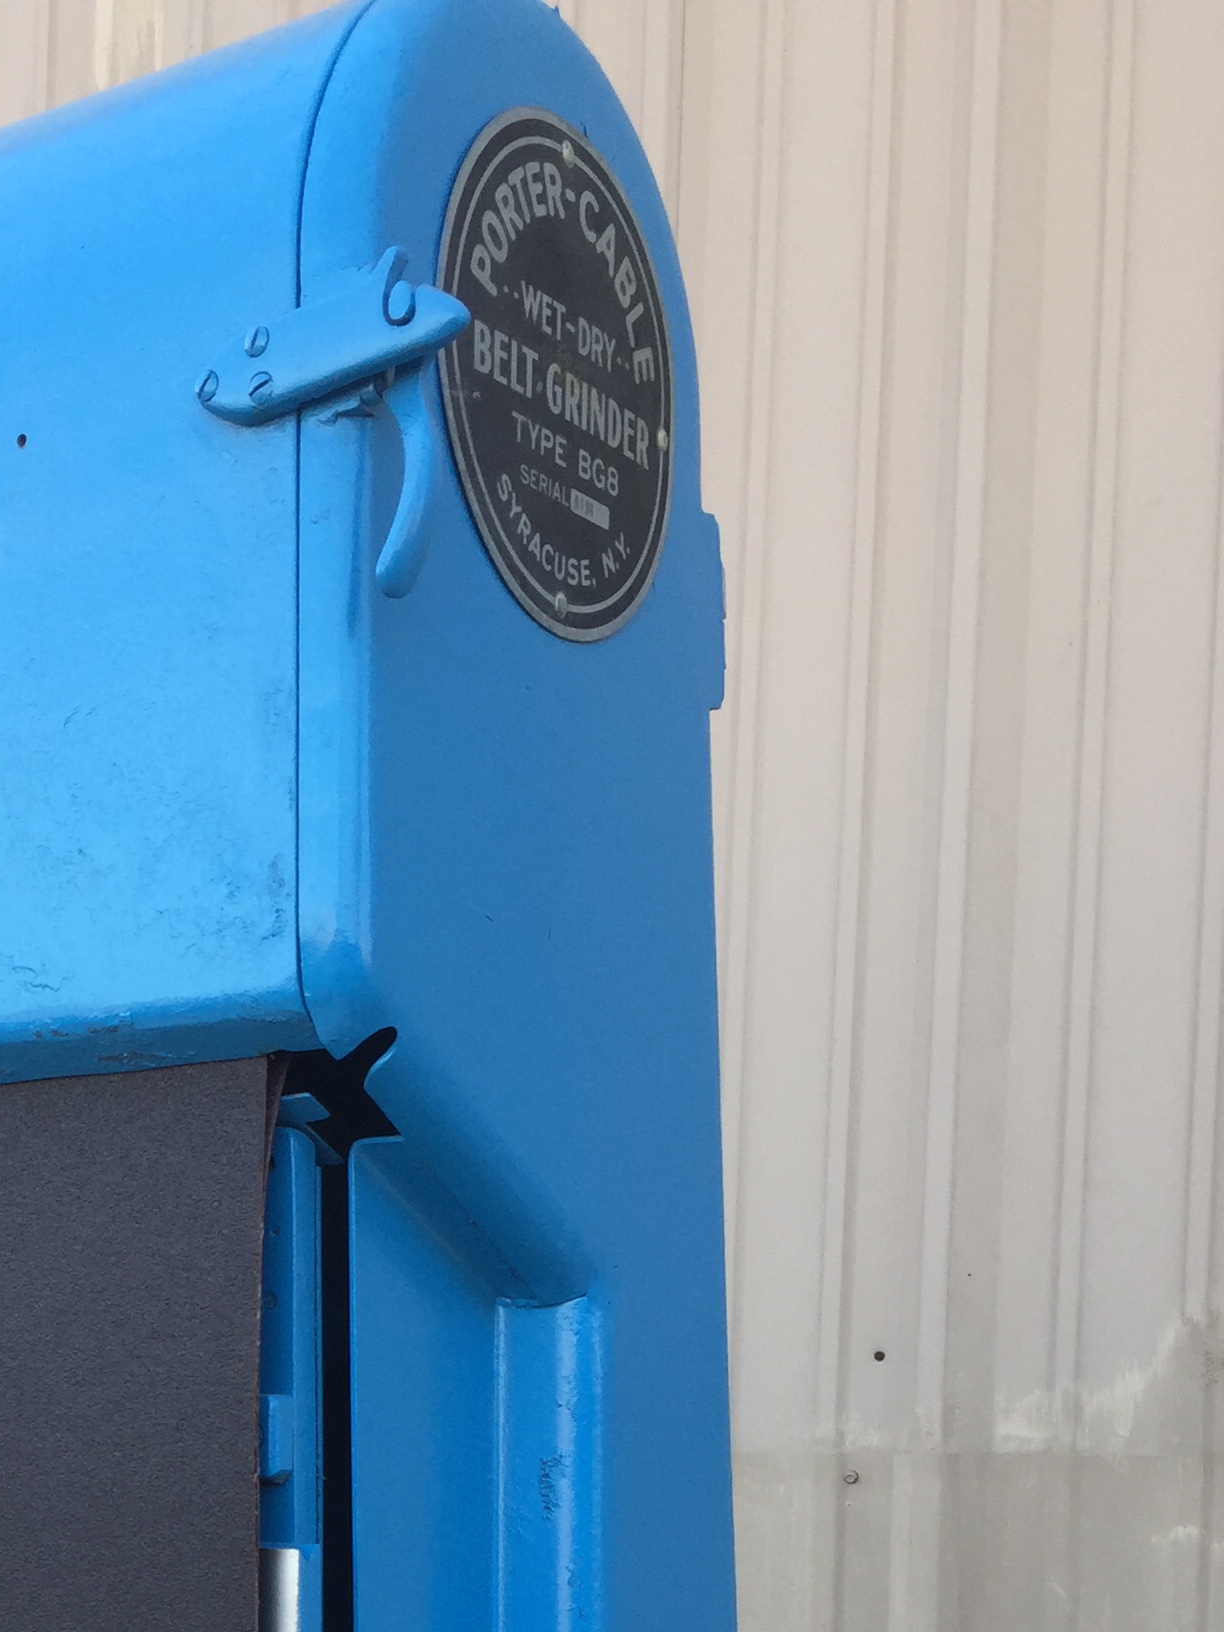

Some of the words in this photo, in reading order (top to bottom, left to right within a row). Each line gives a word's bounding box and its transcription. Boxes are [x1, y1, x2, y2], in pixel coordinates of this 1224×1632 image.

[470, 161, 656, 385] PORTER-CABLE
[473, 319, 540, 399] BELT
[546, 362, 650, 471] GRINDER
[512, 410, 568, 468] TYPE
[578, 448, 619, 497] BG8
[520, 464, 570, 512] SERIAL
[496, 473, 597, 589] SYRACUSE,
[601, 531, 631, 578] N.Y.
